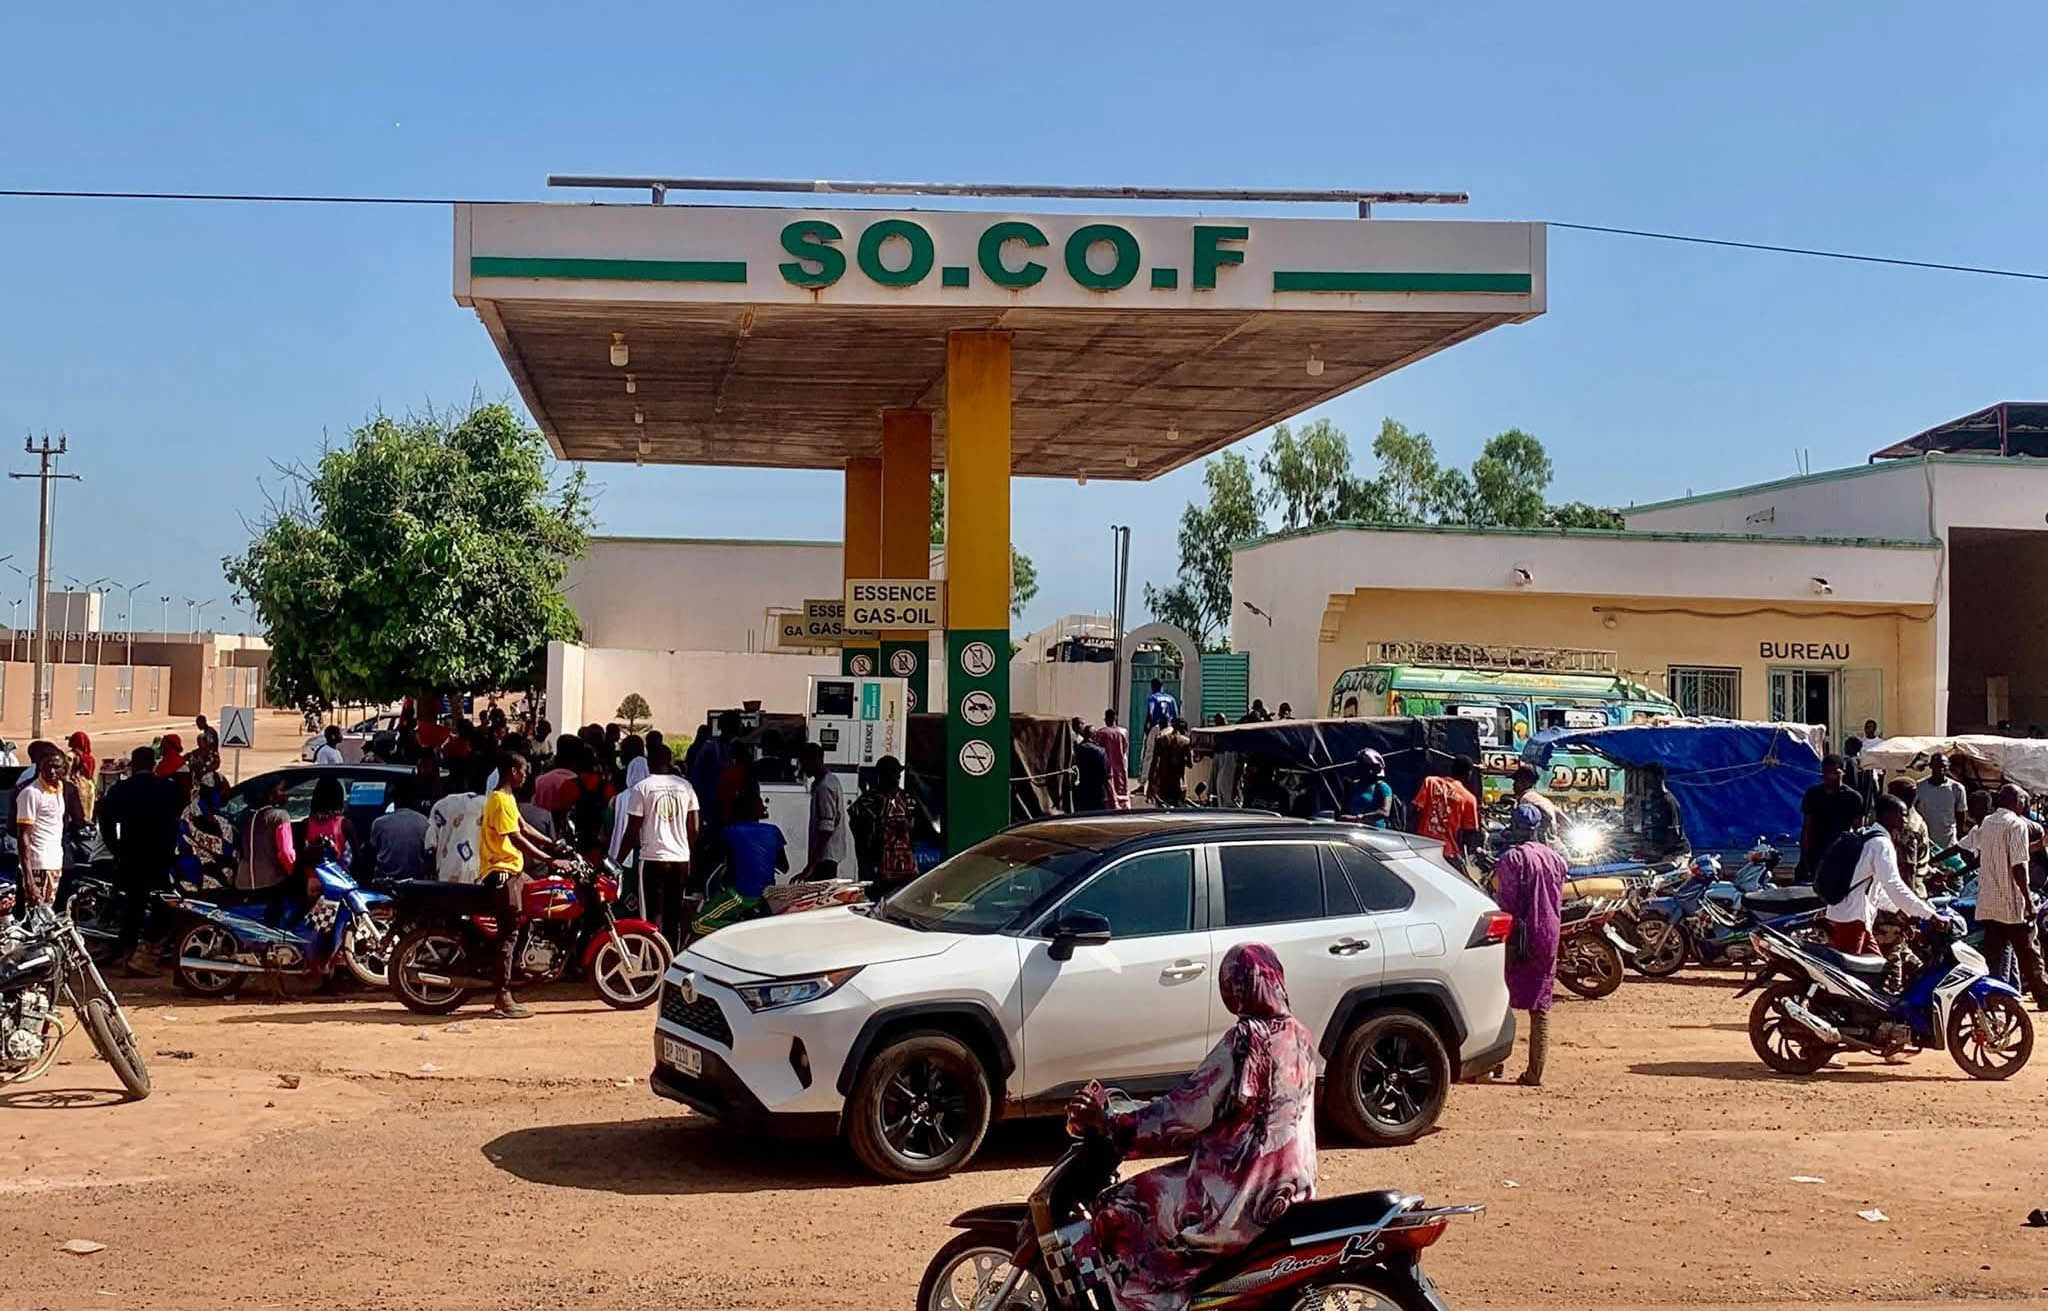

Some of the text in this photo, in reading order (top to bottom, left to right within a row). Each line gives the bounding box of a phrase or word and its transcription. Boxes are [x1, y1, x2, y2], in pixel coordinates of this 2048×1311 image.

[854, 586, 937, 601] ESSENCE
[809, 605, 846, 617] ESSE
[854, 608, 936, 624] GAS-OIL
[1760, 642, 1850, 660] BUREAU
[1550, 765, 1609, 789] DEN
